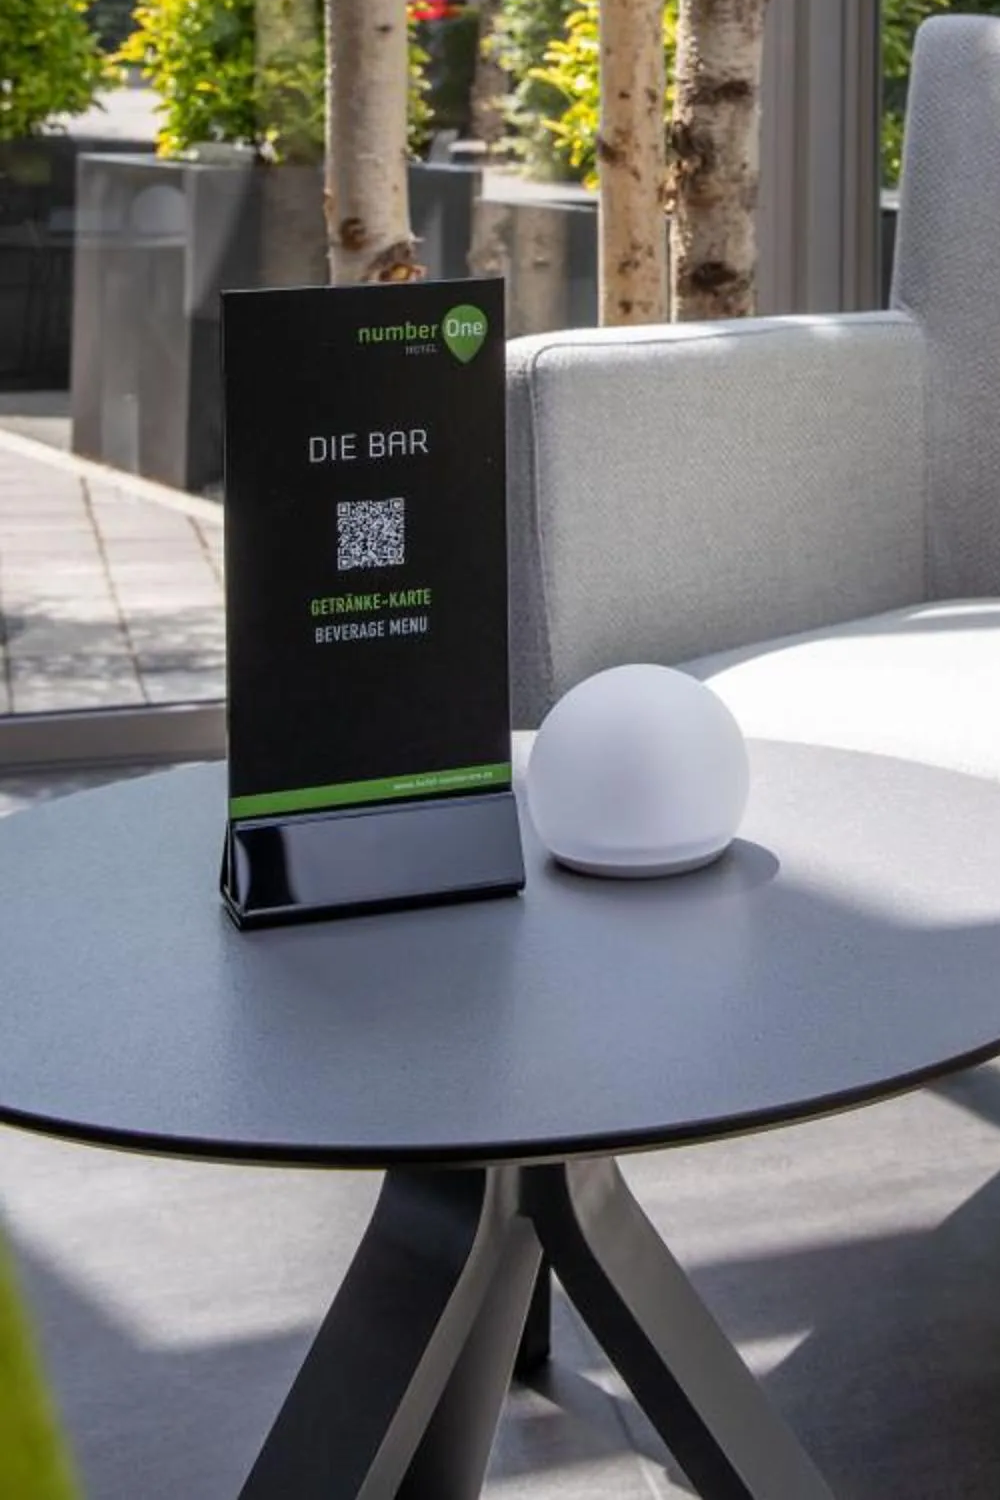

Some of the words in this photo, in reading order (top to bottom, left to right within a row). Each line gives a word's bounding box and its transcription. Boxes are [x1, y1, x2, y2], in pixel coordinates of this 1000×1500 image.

[358, 320, 440, 343] number
[447, 318, 484, 337] One
[309, 433, 357, 462] DIE
[369, 429, 429, 457] BAR
[311, 588, 432, 616] GETRÄNKE-KARTE
[315, 621, 385, 644] BEVERAGE
[389, 616, 428, 636] MENU
